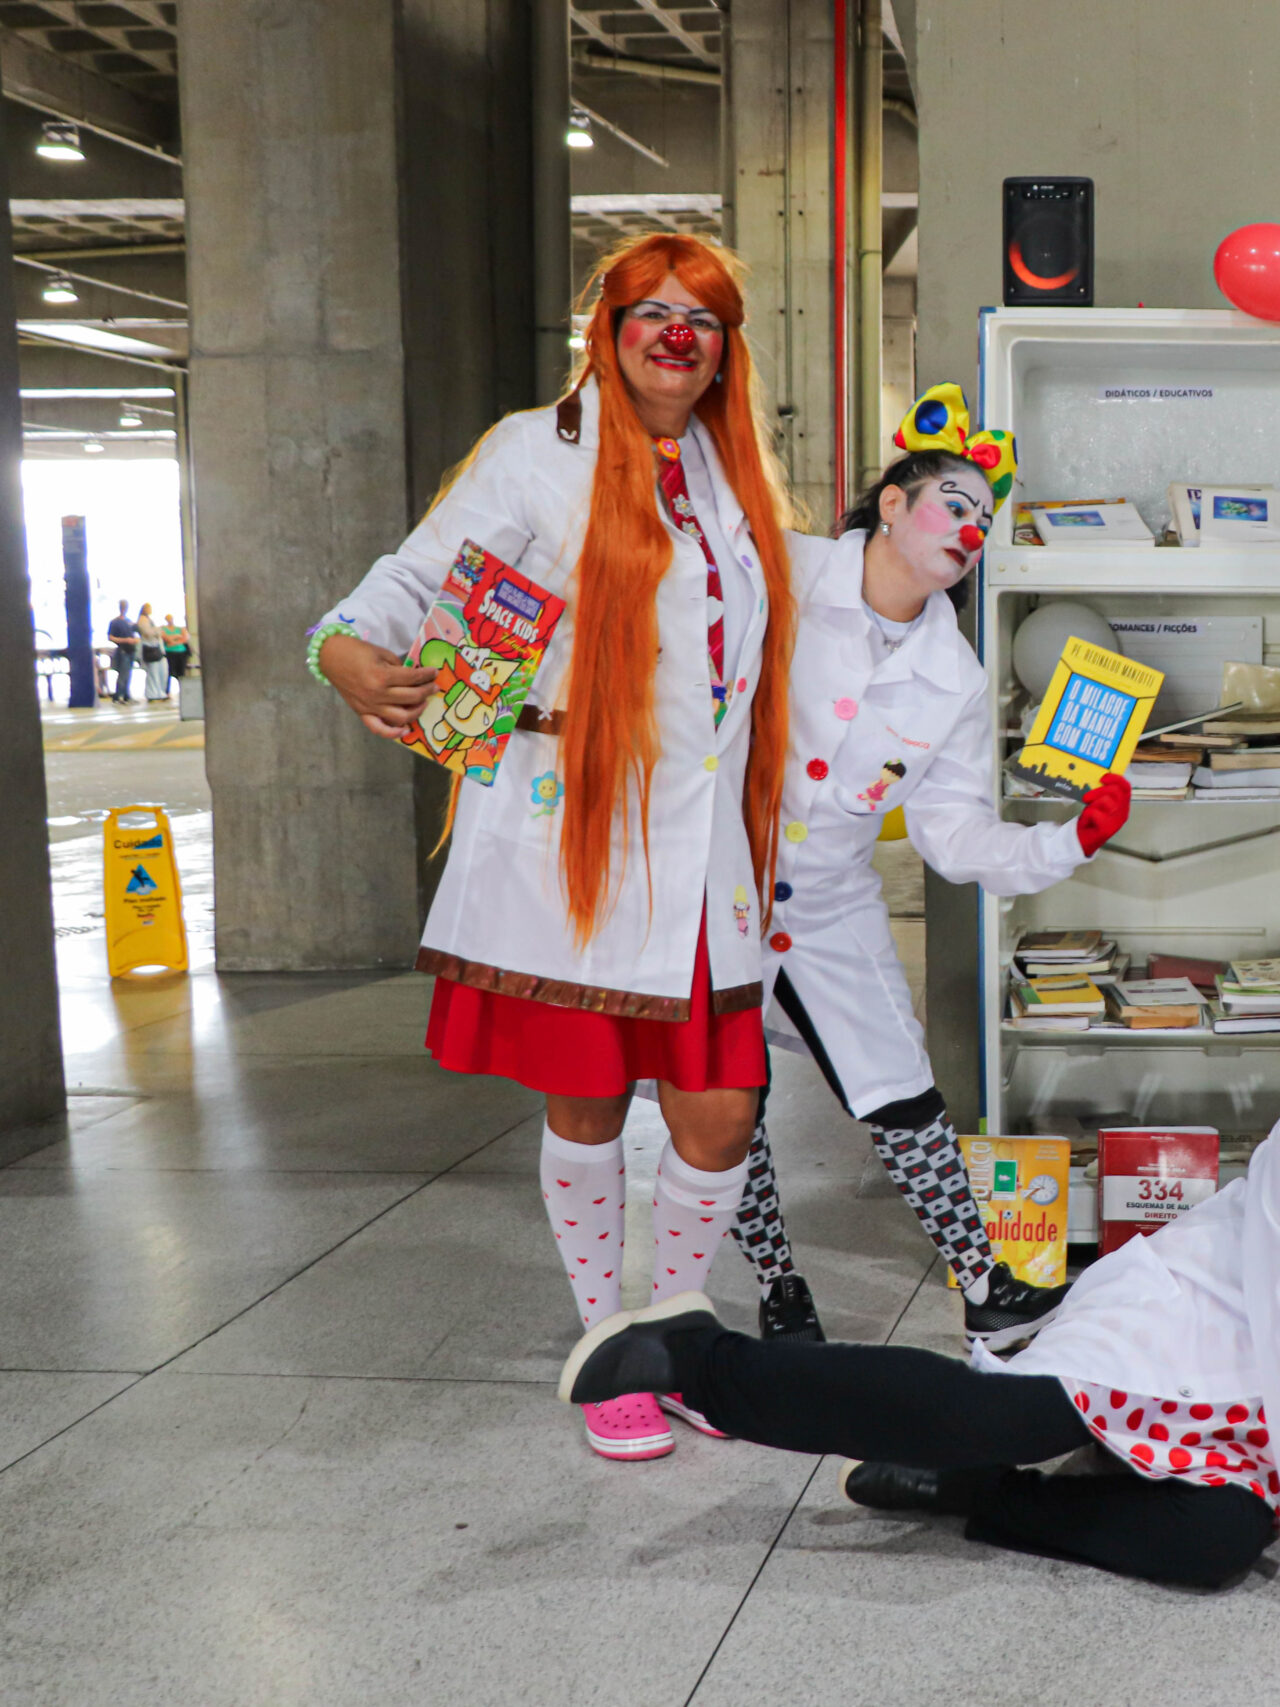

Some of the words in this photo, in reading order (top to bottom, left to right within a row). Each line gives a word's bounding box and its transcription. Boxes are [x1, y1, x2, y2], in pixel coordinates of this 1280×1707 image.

[1105, 388, 1151, 398] DIDÁTICOS
[1160, 389, 1213, 398] EDUCATIVOS
[478, 589, 515, 629] SPACE
[512, 617, 540, 644] KIDS
[1163, 623, 1197, 635] FICÇÕES
[1068, 679, 1082, 701] O
[1080, 684, 1131, 719] MILAGRE
[1061, 700, 1080, 724] DA
[1052, 721, 1081, 750] COM
[1079, 731, 1112, 762] DEUS
[1138, 1179, 1184, 1201] 334
[1126, 1201, 1164, 1210] ESQUEMAS
[1144, 1211, 1178, 1220] DIREITO
[985, 1210, 1058, 1242] alidade
